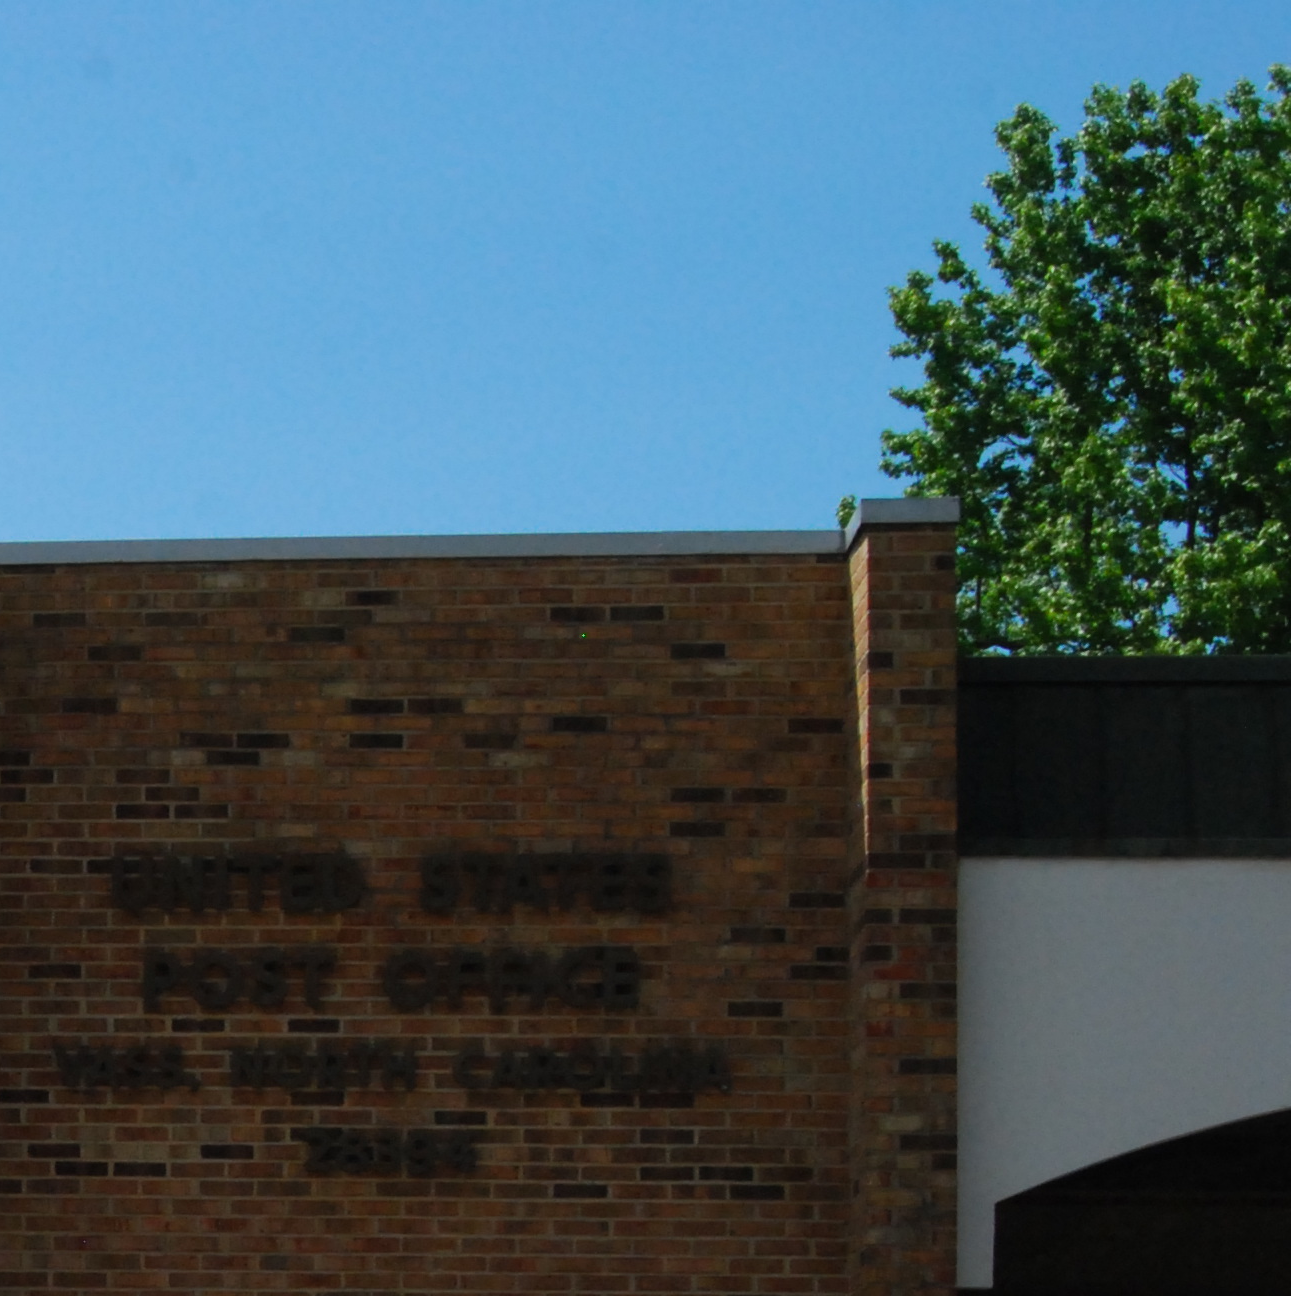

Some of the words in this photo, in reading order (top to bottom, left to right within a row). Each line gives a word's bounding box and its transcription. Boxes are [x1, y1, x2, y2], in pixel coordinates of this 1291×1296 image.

[112, 853, 365, 915] UNITED
[422, 853, 671, 915] STATES
[143, 945, 337, 1012] POST
[384, 945, 641, 1010] OFFICE
[54, 1043, 201, 1092] VASS,
[230, 1043, 417, 1090] NORTH
[453, 1043, 732, 1092] CAROLINA
